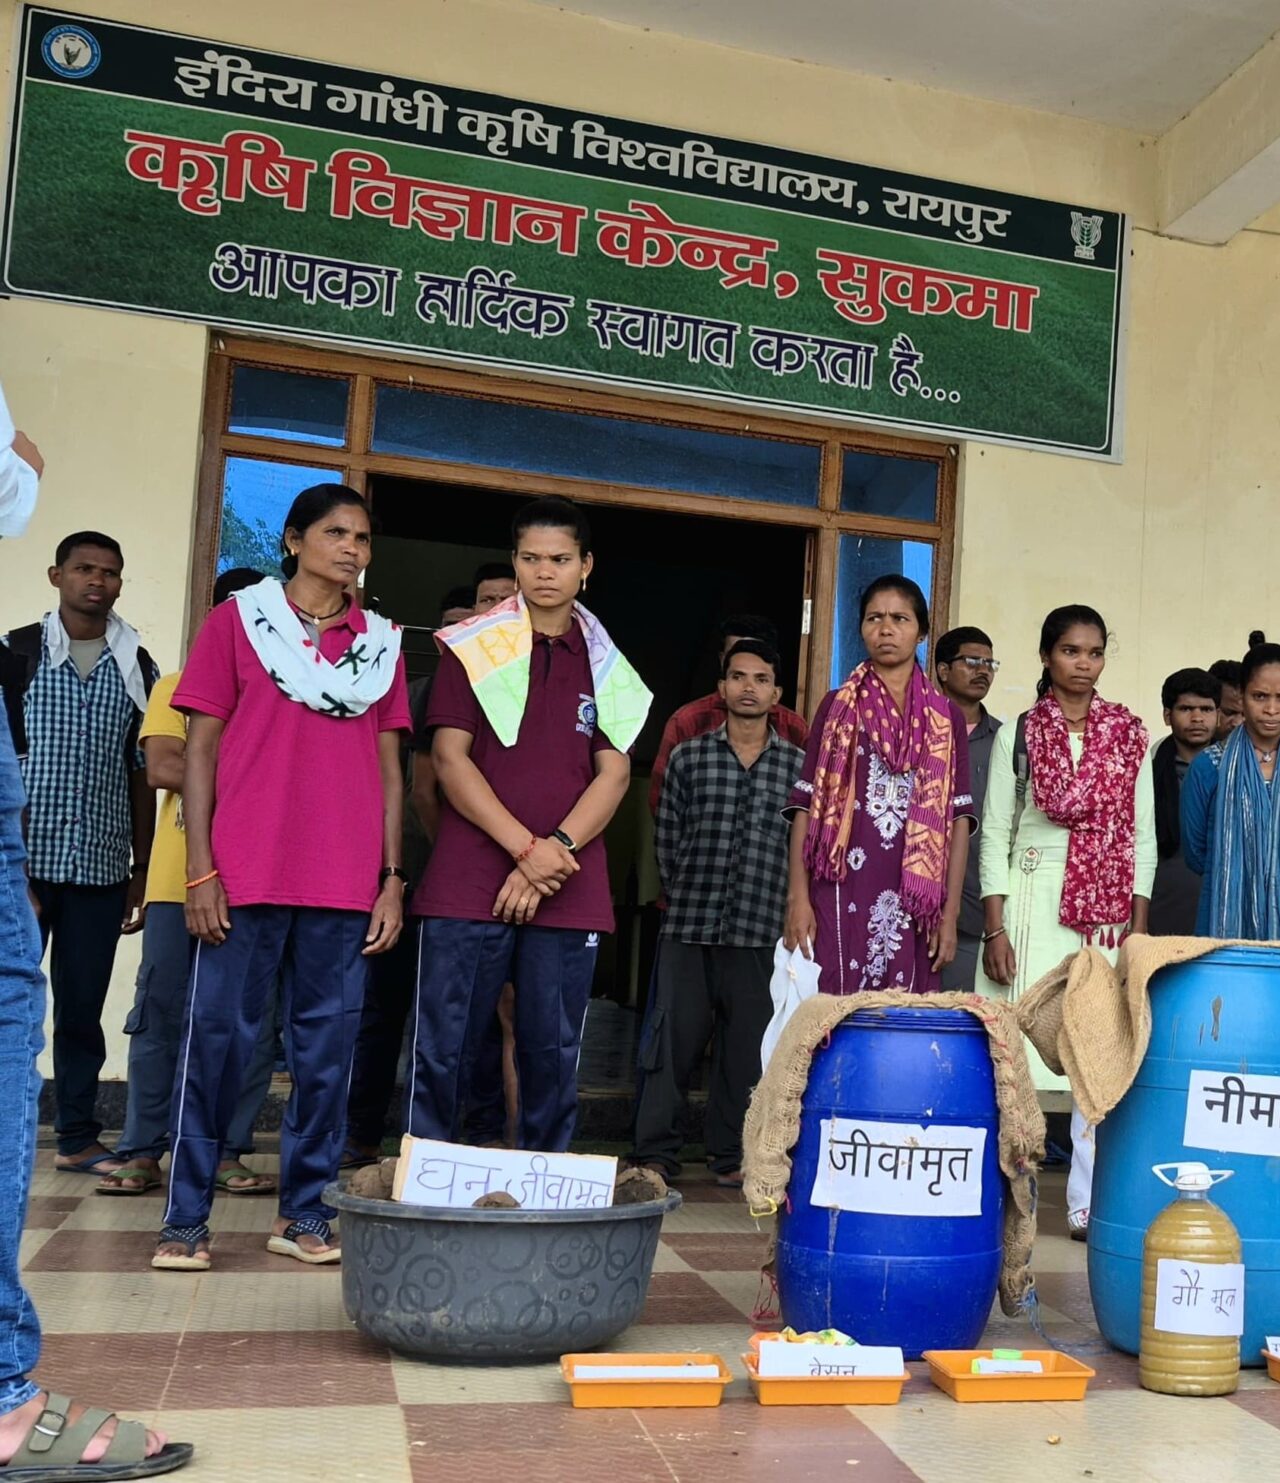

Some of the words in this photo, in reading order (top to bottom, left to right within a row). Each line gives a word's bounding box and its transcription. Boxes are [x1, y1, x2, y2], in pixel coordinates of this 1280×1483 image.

[173, 50, 317, 112] इंदिरा
[326, 81, 449, 134] गांधी
[457, 109, 564, 156] कृषि
[571, 119, 869, 216] विश्वविद्यालय,
[883, 186, 1011, 243] रायपुर
[124, 130, 315, 215] कृषि
[325, 149, 586, 256] विज्ञान
[597, 200, 799, 298] केन्द्र,
[817, 247, 1039, 333] सुकमा
[209, 243, 402, 316] आपका
[415, 266, 575, 338] हार्दिक
[587, 299, 741, 369] स्वागत
[749, 325, 878, 391] करता
[829, 1129, 973, 1196] जीवामृत
[1171, 1268, 1205, 1307] गौ
